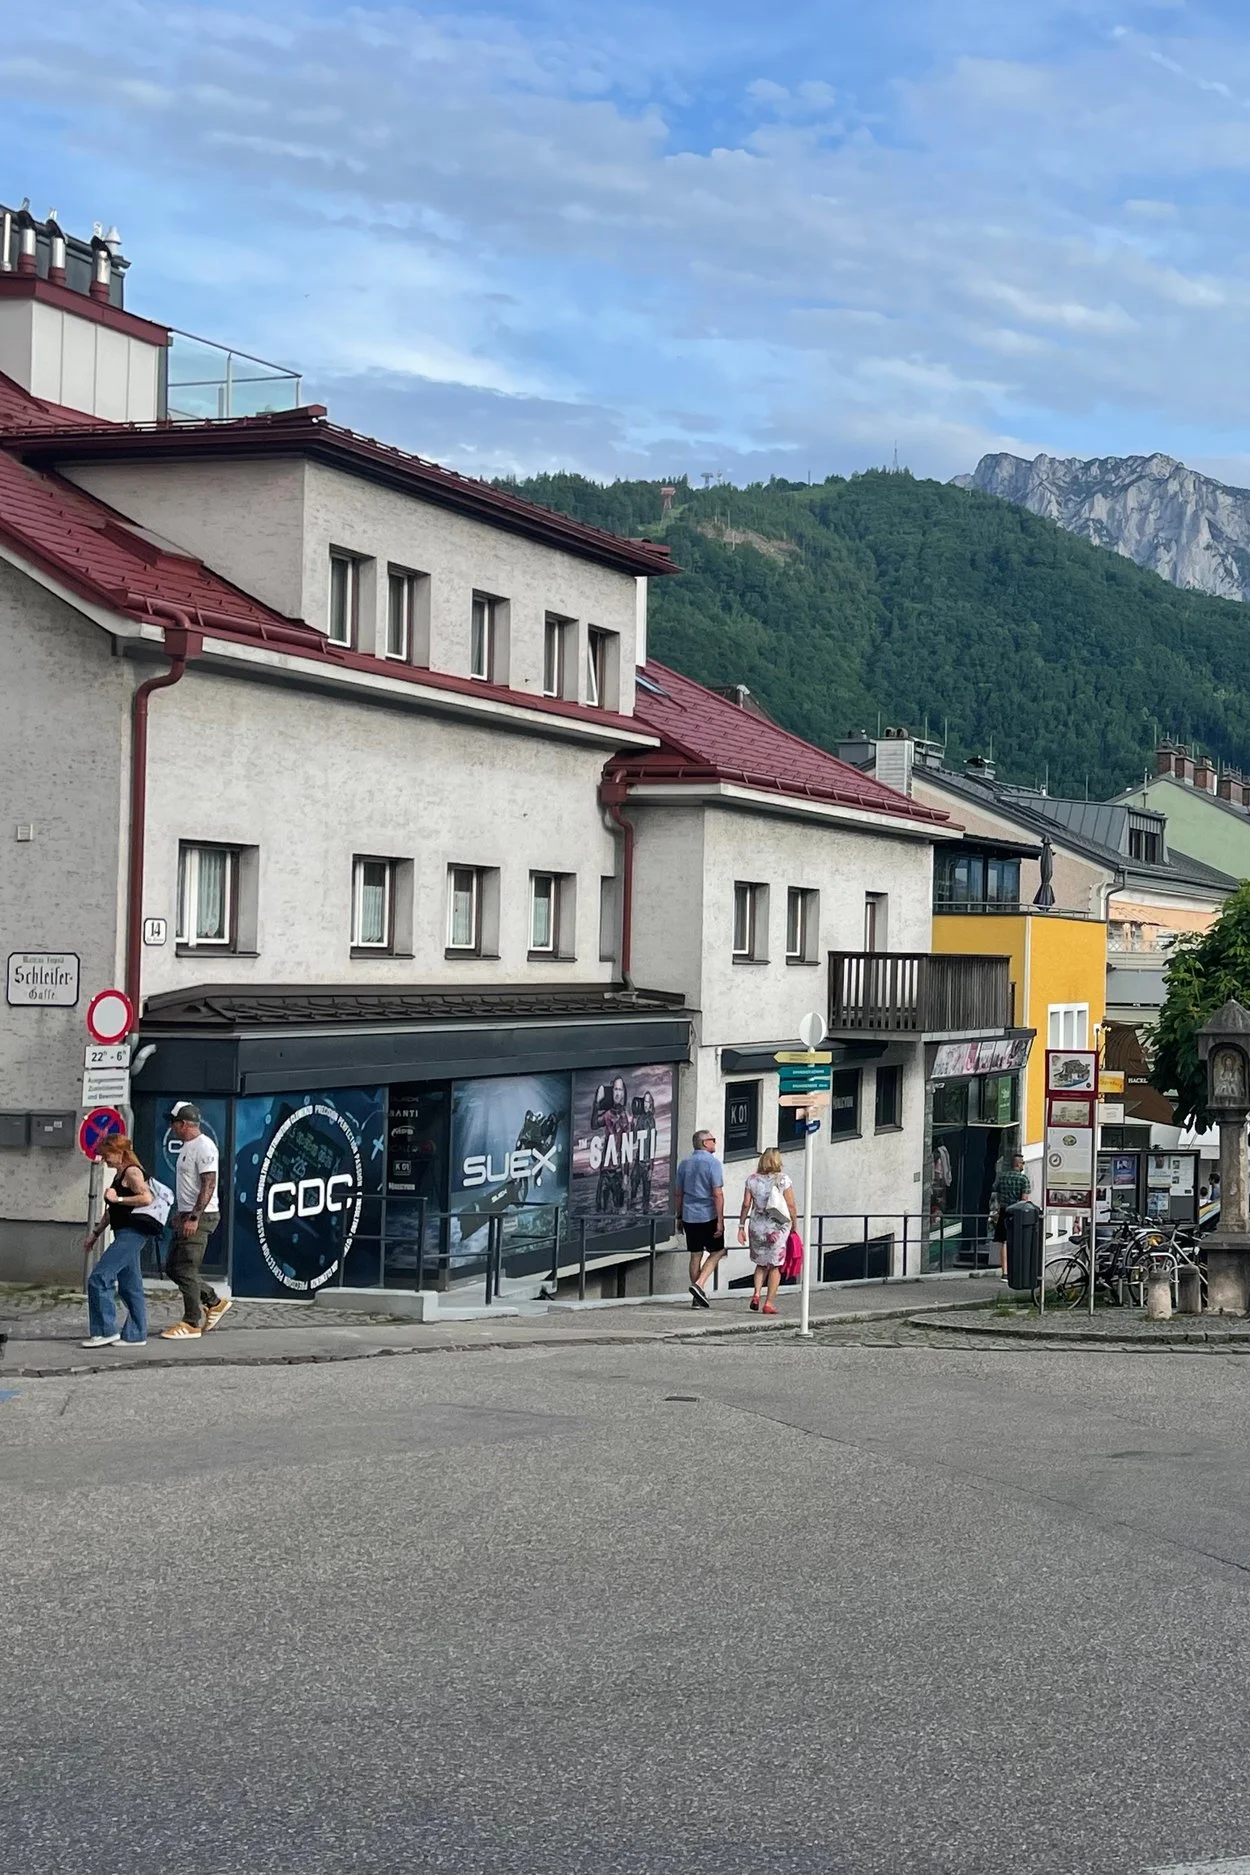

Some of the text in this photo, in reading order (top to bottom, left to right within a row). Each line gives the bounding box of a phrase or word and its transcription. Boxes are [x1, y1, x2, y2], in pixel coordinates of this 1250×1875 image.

[151, 922, 161, 937] 14
[463, 1146, 557, 1187] SUEX
[589, 1128, 656, 1170] SANTI
[268, 1174, 353, 1222] CDC
